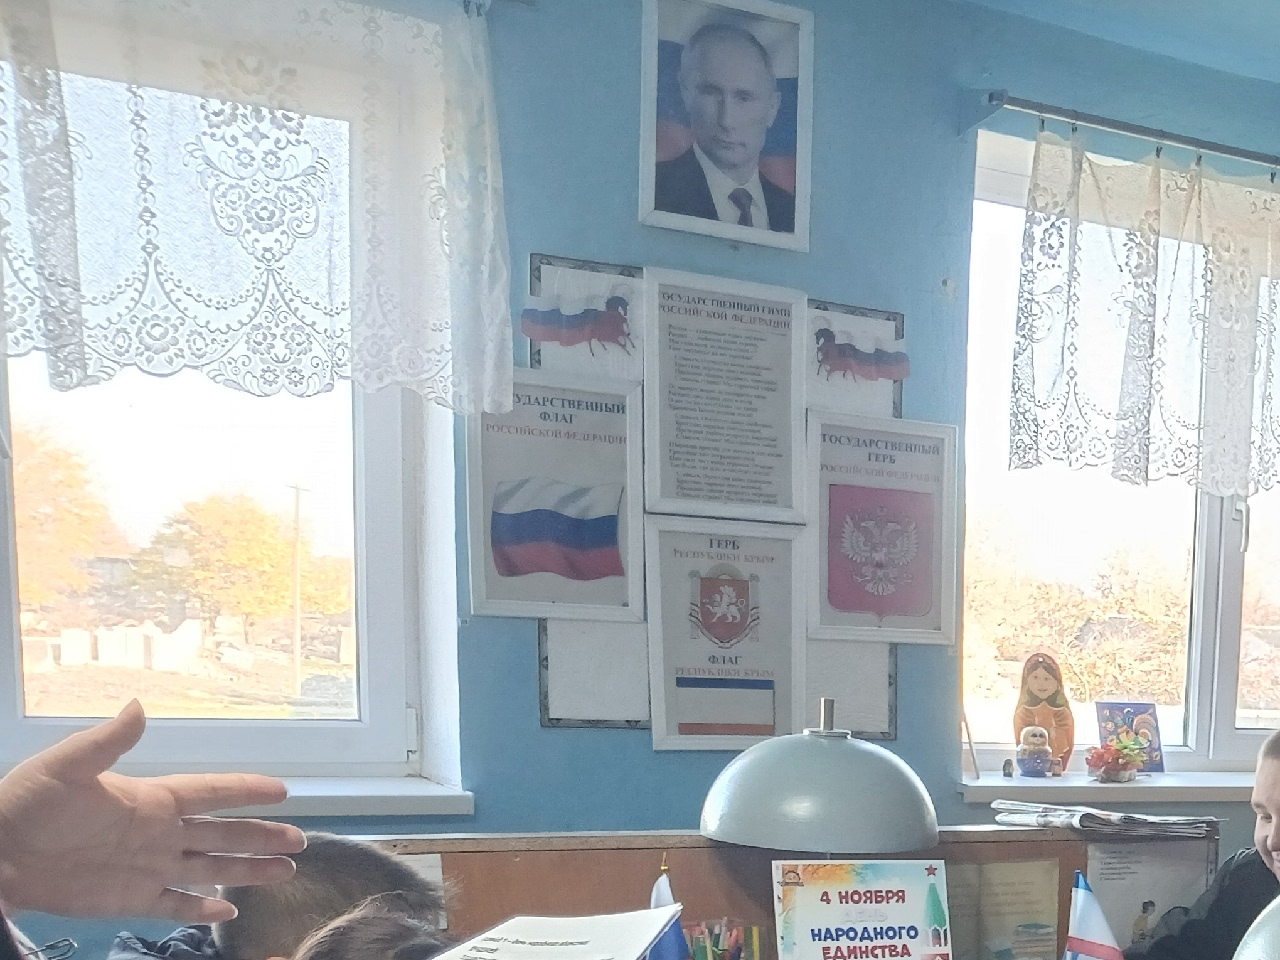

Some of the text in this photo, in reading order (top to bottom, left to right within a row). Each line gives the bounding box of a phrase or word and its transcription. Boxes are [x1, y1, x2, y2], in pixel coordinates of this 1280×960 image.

[661, 291, 759, 313] ОСУДАРСТВЕННЫЙ
[513, 392, 627, 415] УДАРСТВЕННЫЙ
[539, 411, 577, 424] ФЛАГ
[485, 423, 627, 445] РОССИЙСКОЙ ФЕДЕРАЦИИ
[821, 433, 940, 456] ГОСУДАРСТВЕННЫЙ
[867, 451, 896, 464] ГЕРБ
[708, 538, 740, 550] ГЕРБ
[707, 655, 742, 665] ФЛАГ
[820, 889, 906, 905] 4 НОЯБРЯ
[841, 908, 888, 924] ДЕНЬ
[811, 925, 919, 943] НАРОДНОГО
